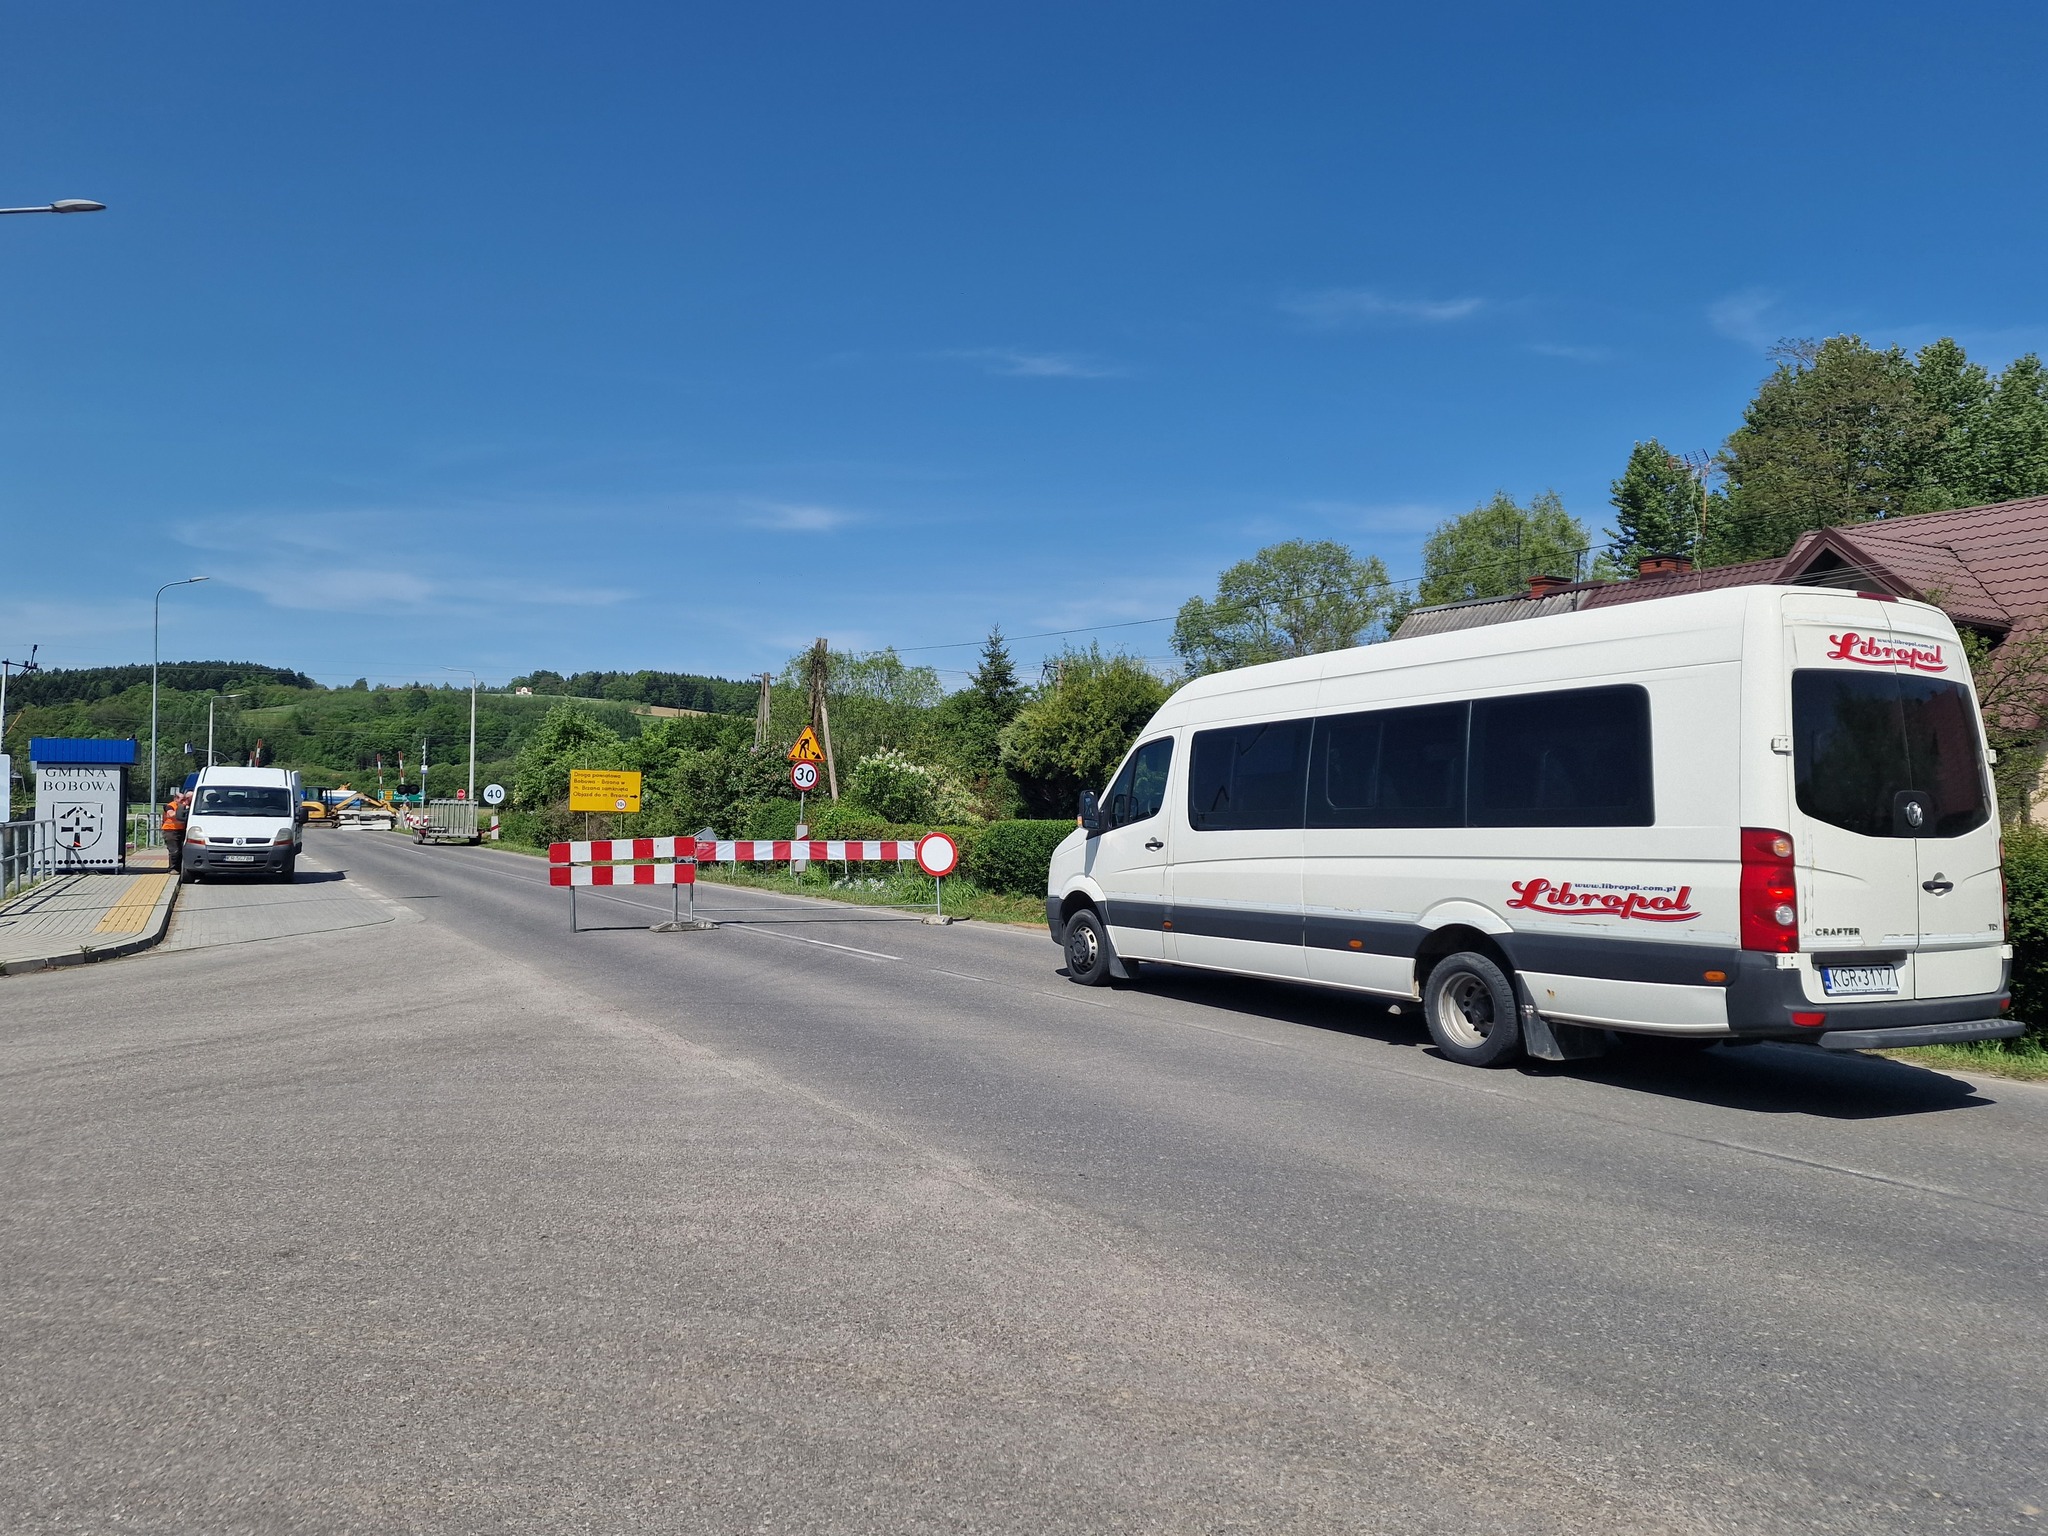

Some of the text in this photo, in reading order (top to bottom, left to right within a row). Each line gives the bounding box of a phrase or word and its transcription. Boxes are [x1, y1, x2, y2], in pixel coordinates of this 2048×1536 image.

[1827, 632, 1945, 670] Libropol
[45, 767, 108, 778] GMINA
[796, 767, 815, 783] 30
[43, 781, 116, 792] BOBOWA
[487, 788, 502, 799] 40
[1574, 881, 1677, 893] www.libropol.com.pl
[1506, 878, 1694, 920] Libropol
[1814, 927, 1860, 936] CRAFTER
[1832, 968, 1858, 987] KGR
